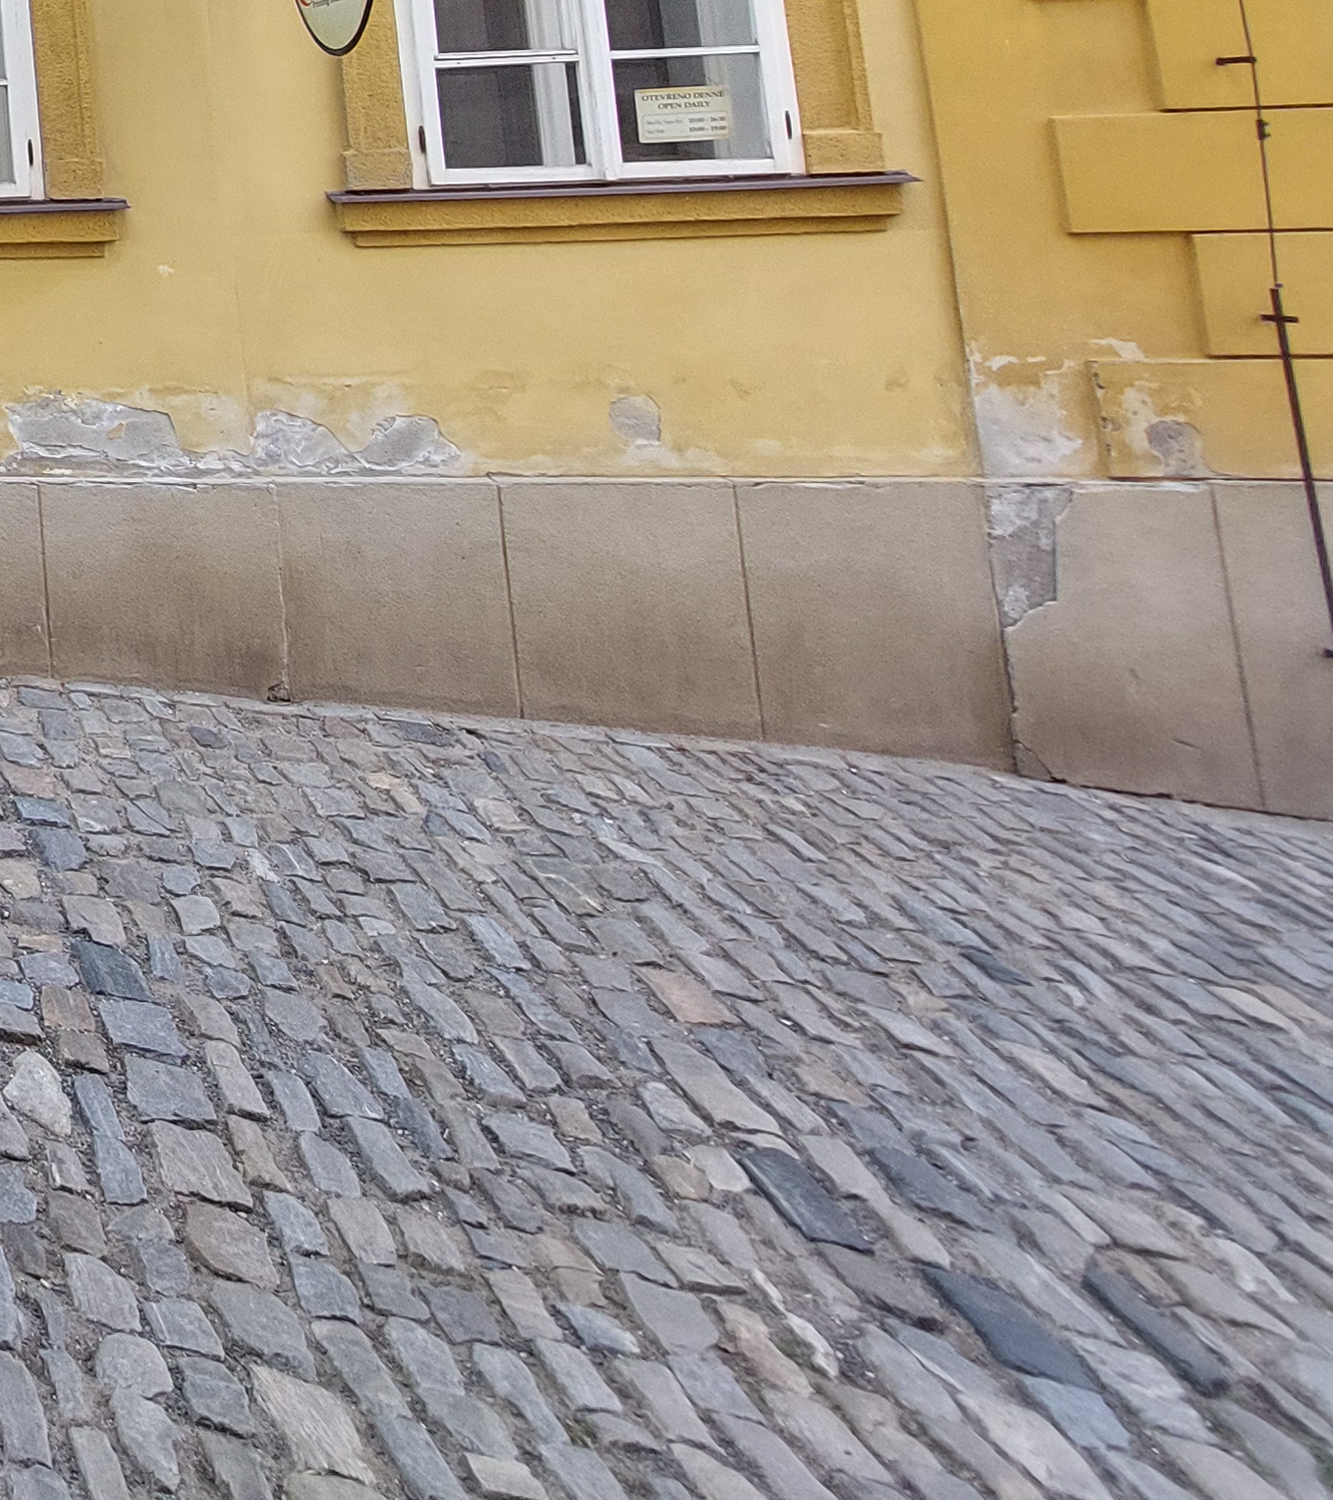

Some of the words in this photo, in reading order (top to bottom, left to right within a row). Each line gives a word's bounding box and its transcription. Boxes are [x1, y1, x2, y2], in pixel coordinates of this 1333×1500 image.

[641, 92, 691, 102] OTEVŘENO
[657, 101, 682, 109] OPEN
[684, 100, 710, 108] DAILY
